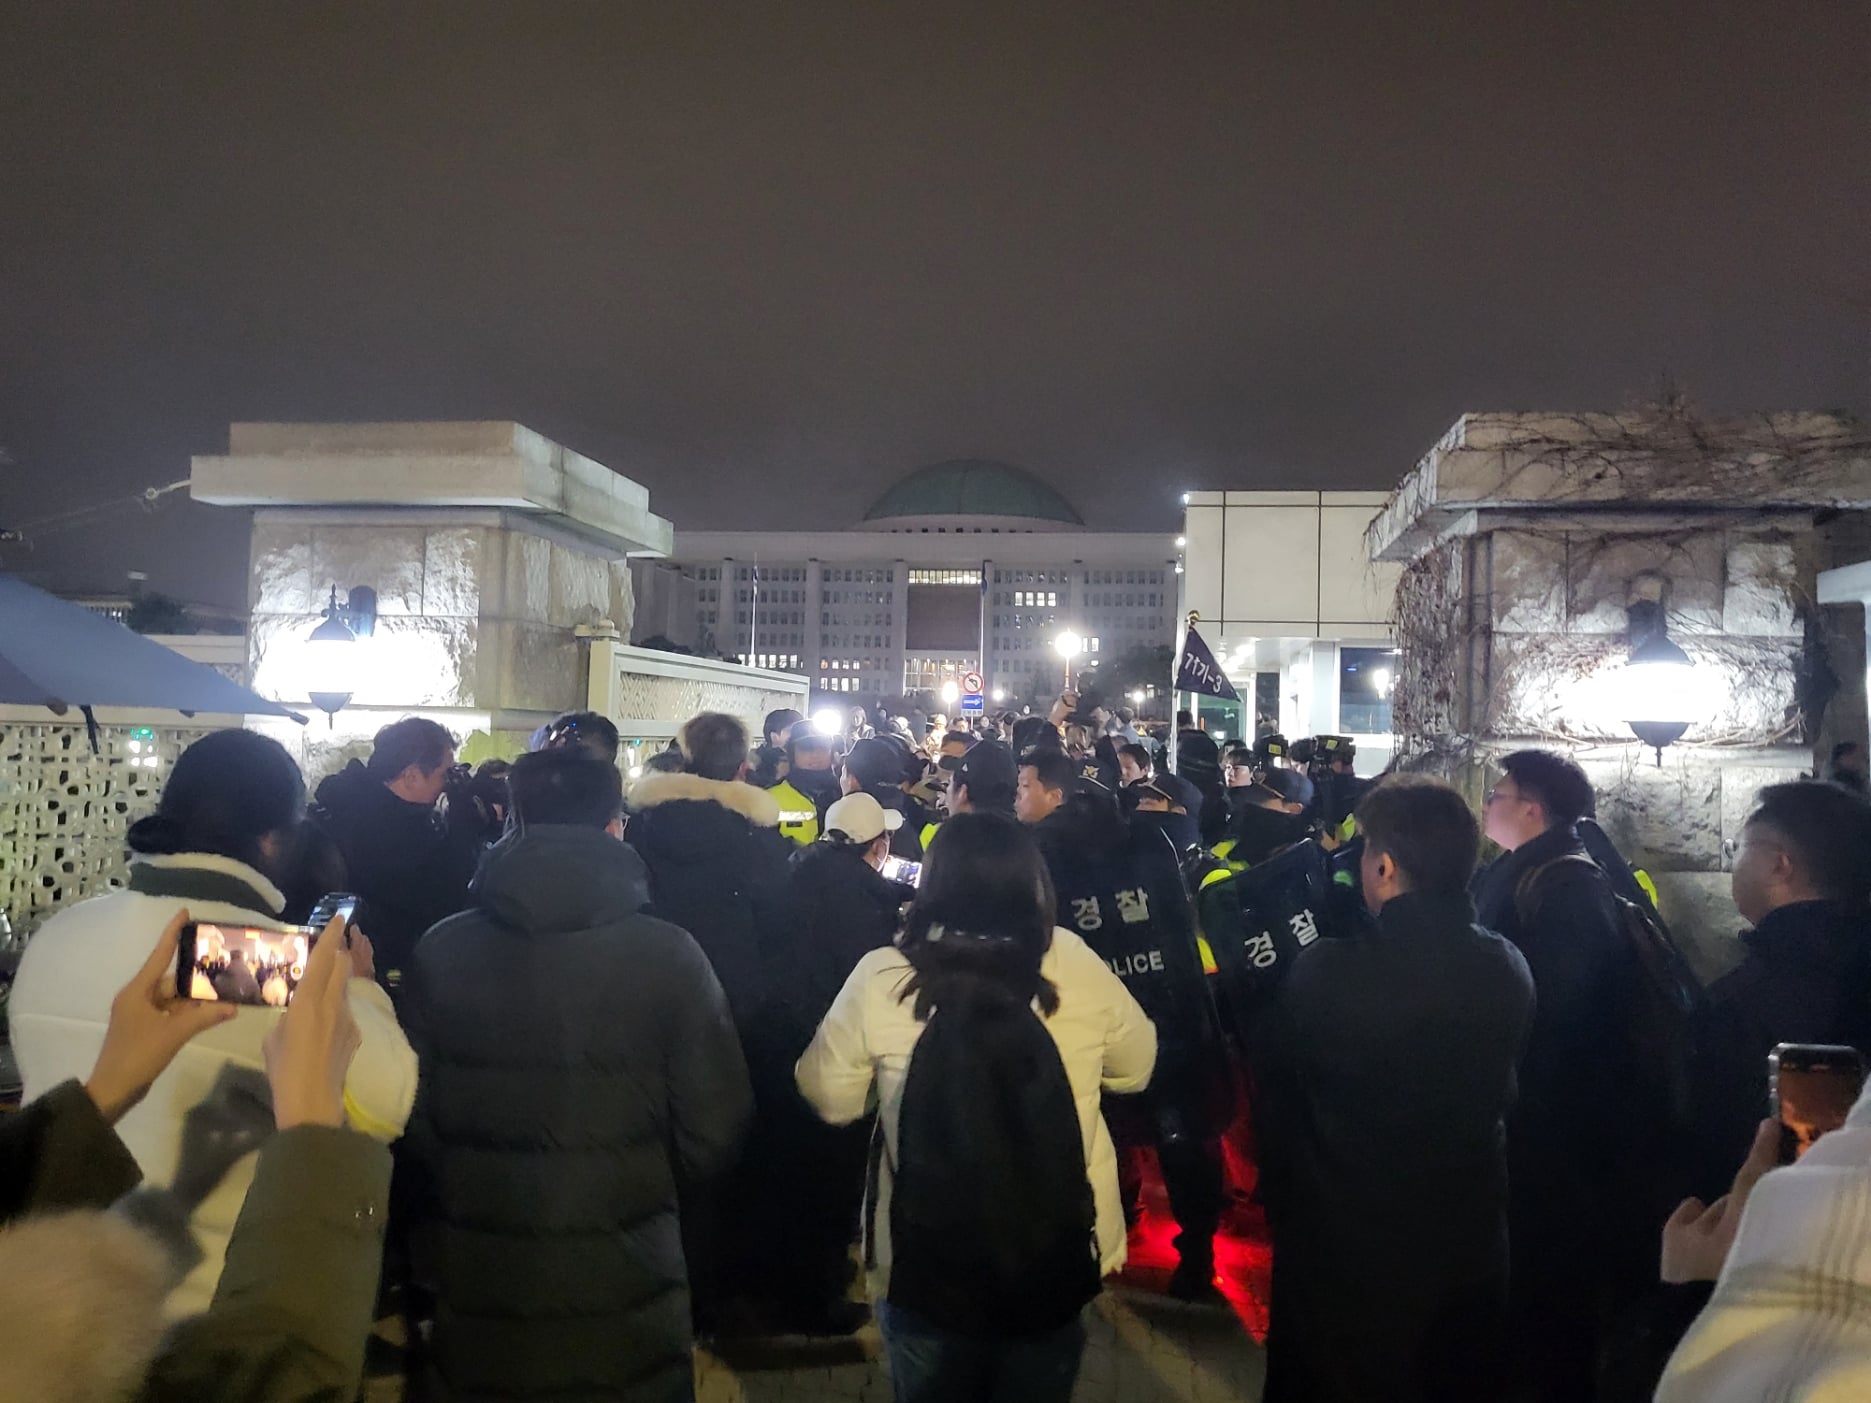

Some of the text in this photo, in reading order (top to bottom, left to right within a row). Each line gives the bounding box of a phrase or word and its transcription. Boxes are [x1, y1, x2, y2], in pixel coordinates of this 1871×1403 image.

[1071, 887, 1151, 931] 경찰
[1244, 909, 1320, 968] 경찰
[1105, 950, 1165, 976] LICE
